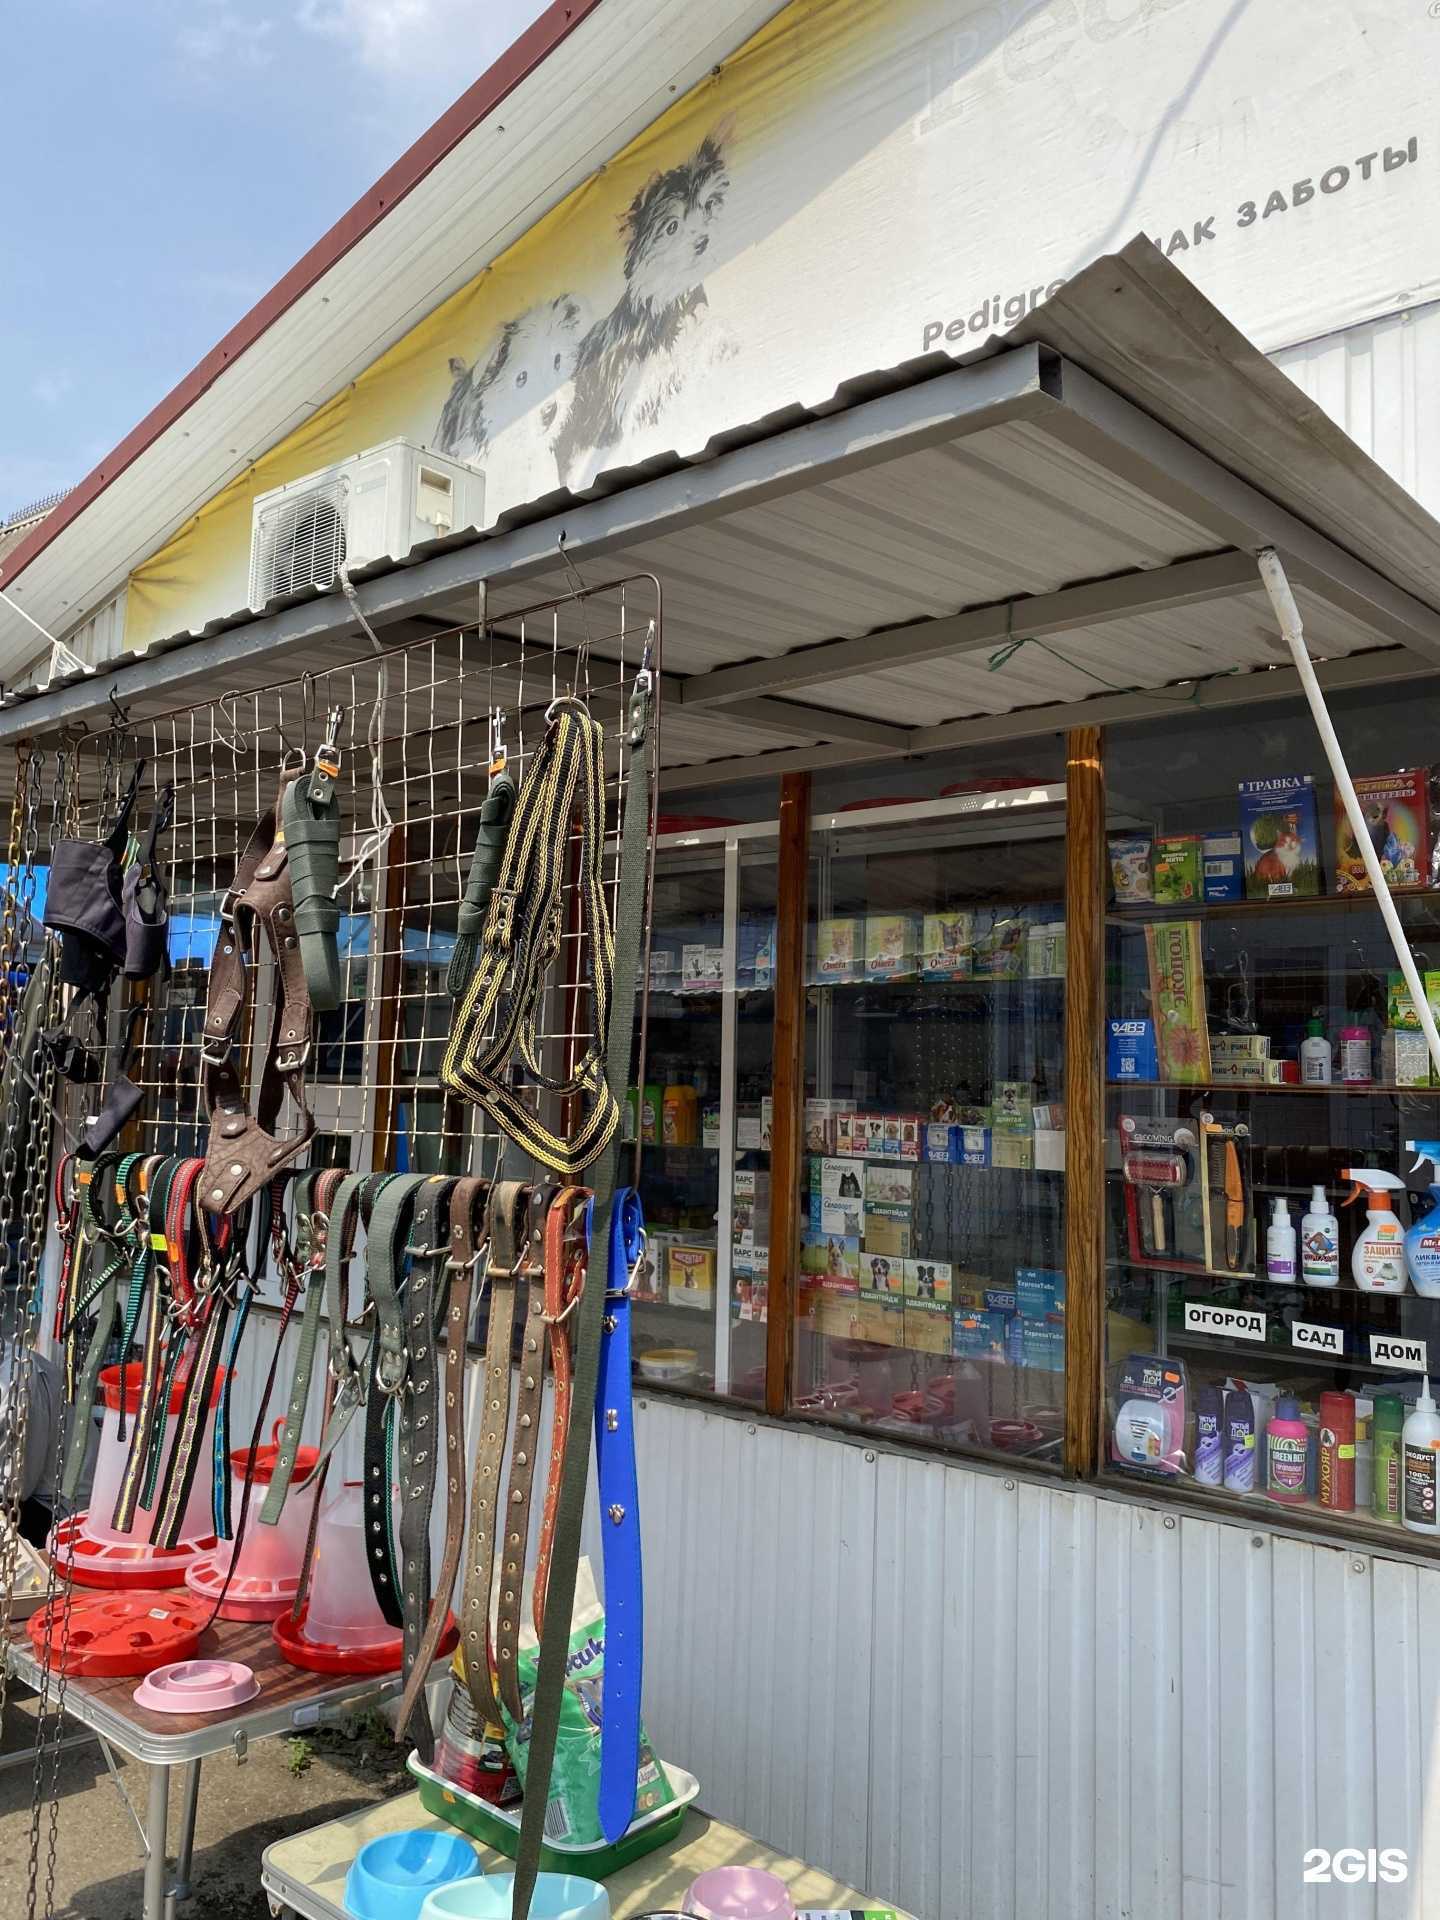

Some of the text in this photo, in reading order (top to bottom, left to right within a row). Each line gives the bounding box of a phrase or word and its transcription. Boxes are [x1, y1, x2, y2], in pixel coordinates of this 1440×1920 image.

[922, 136, 1418, 352] Pedigre АК ЗАБОТЫ
[1247, 777, 1301, 792] ТРАВКА
[735, 1175, 753, 1184] БАРС
[754, 1250, 768, 1258] БАР
[1364, 1245, 1402, 1256] ЗАЩИТА
[1188, 1309, 1262, 1333] ОГОРОД
[1296, 1328, 1337, 1349] САД
[1374, 1342, 1422, 1362] ДОМ
[1320, 1447, 1330, 1504] МУХОЯР
